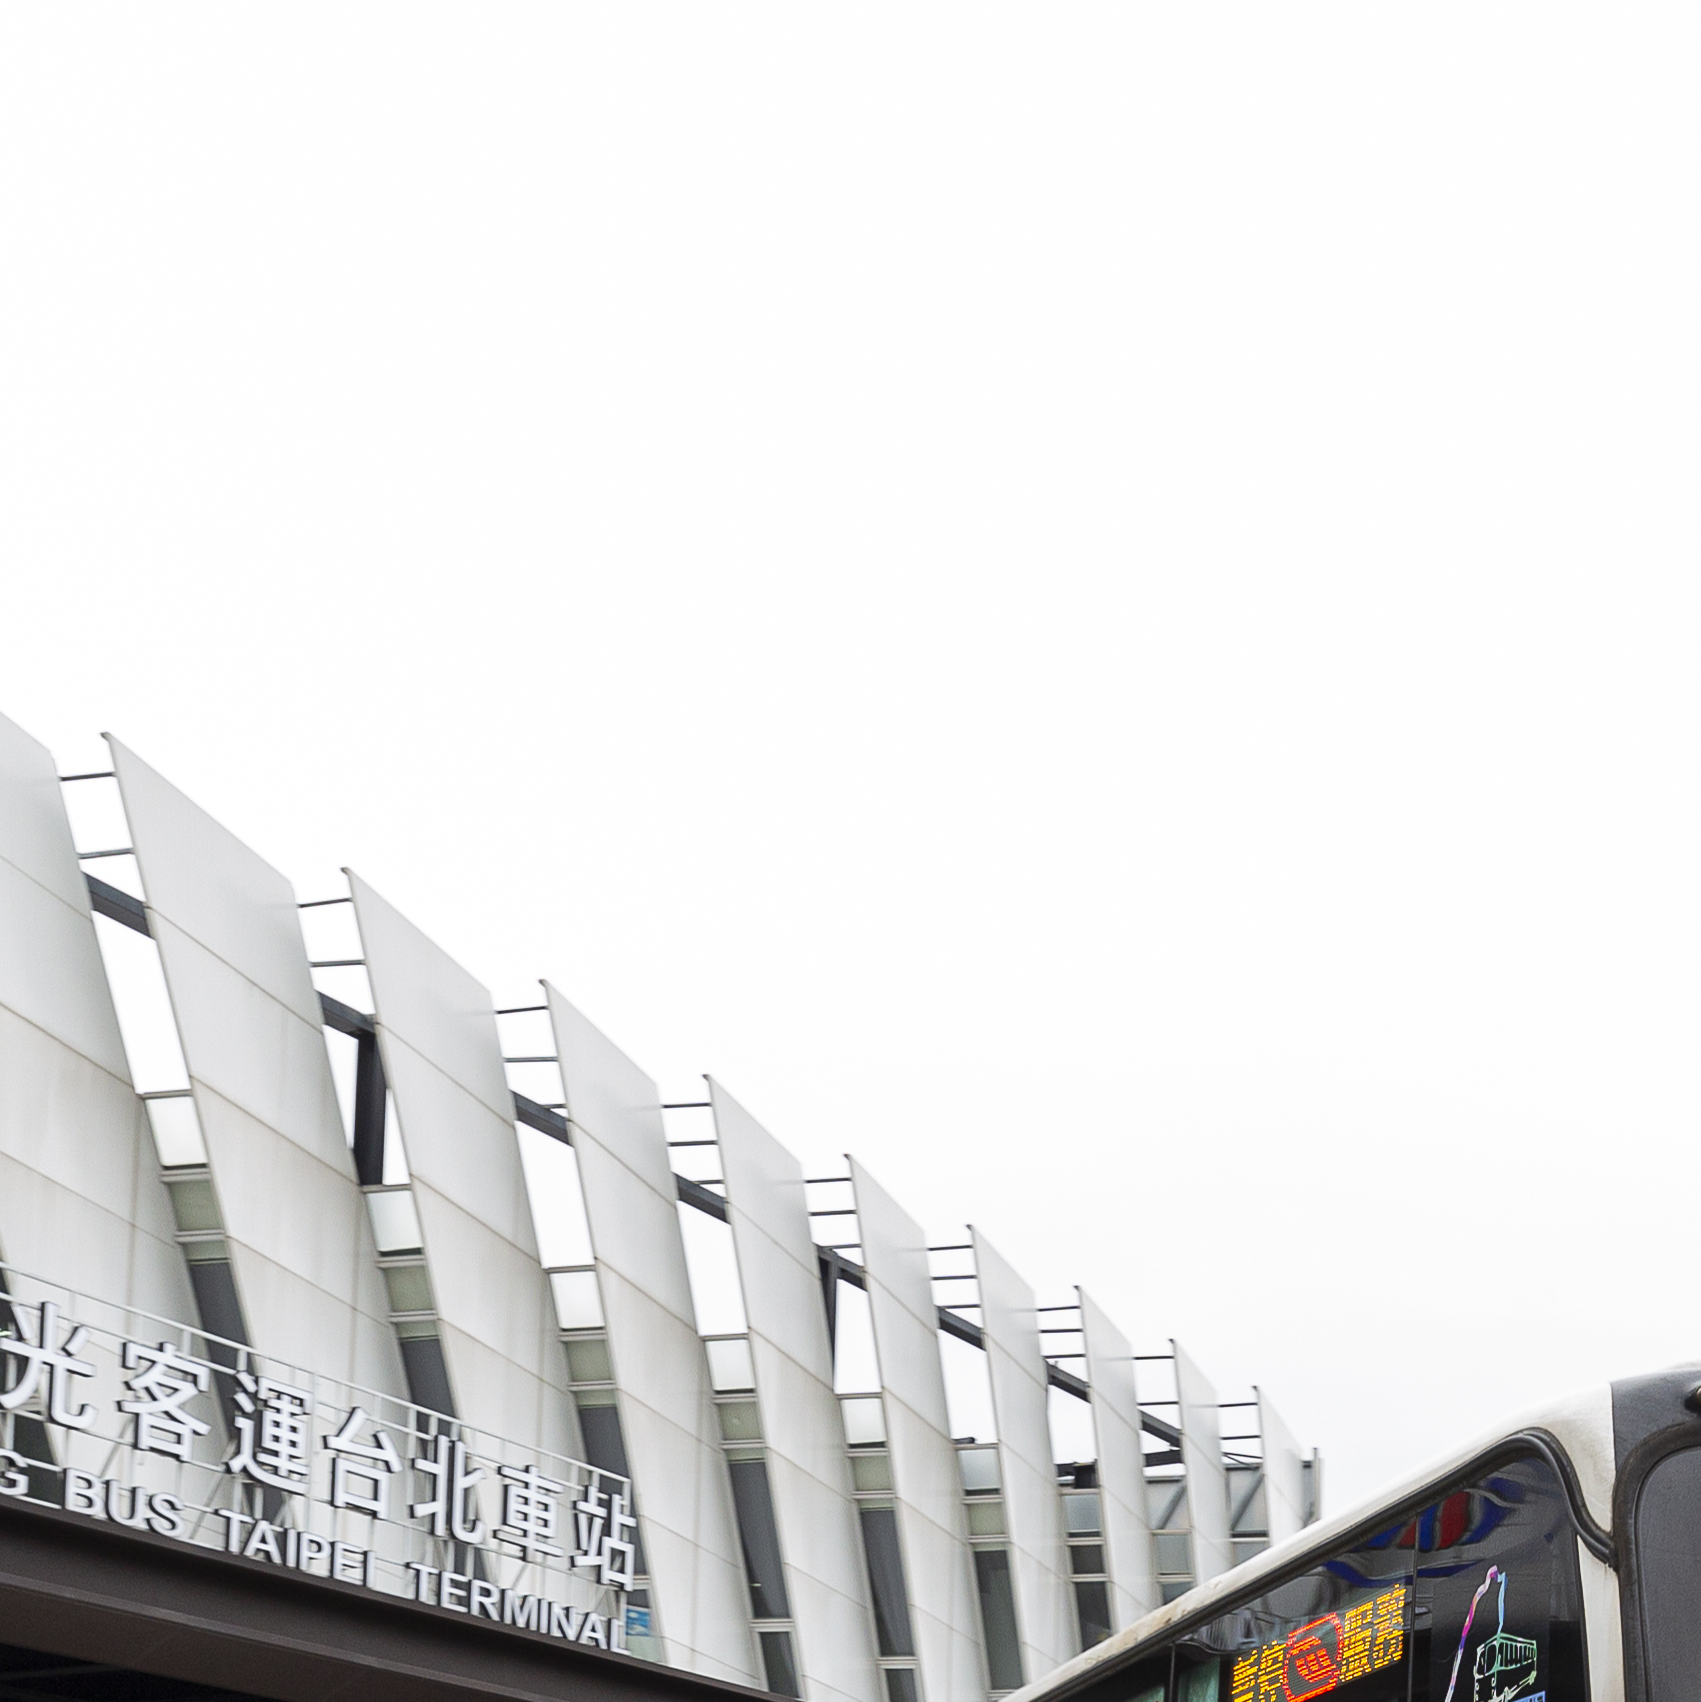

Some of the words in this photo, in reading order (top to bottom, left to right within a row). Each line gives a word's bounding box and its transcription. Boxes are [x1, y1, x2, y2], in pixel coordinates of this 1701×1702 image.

[62, 1467, 187, 1539] BUS
[216, 1508, 376, 1589] TAIPEI
[407, 1561, 632, 1656] TERMINAL
